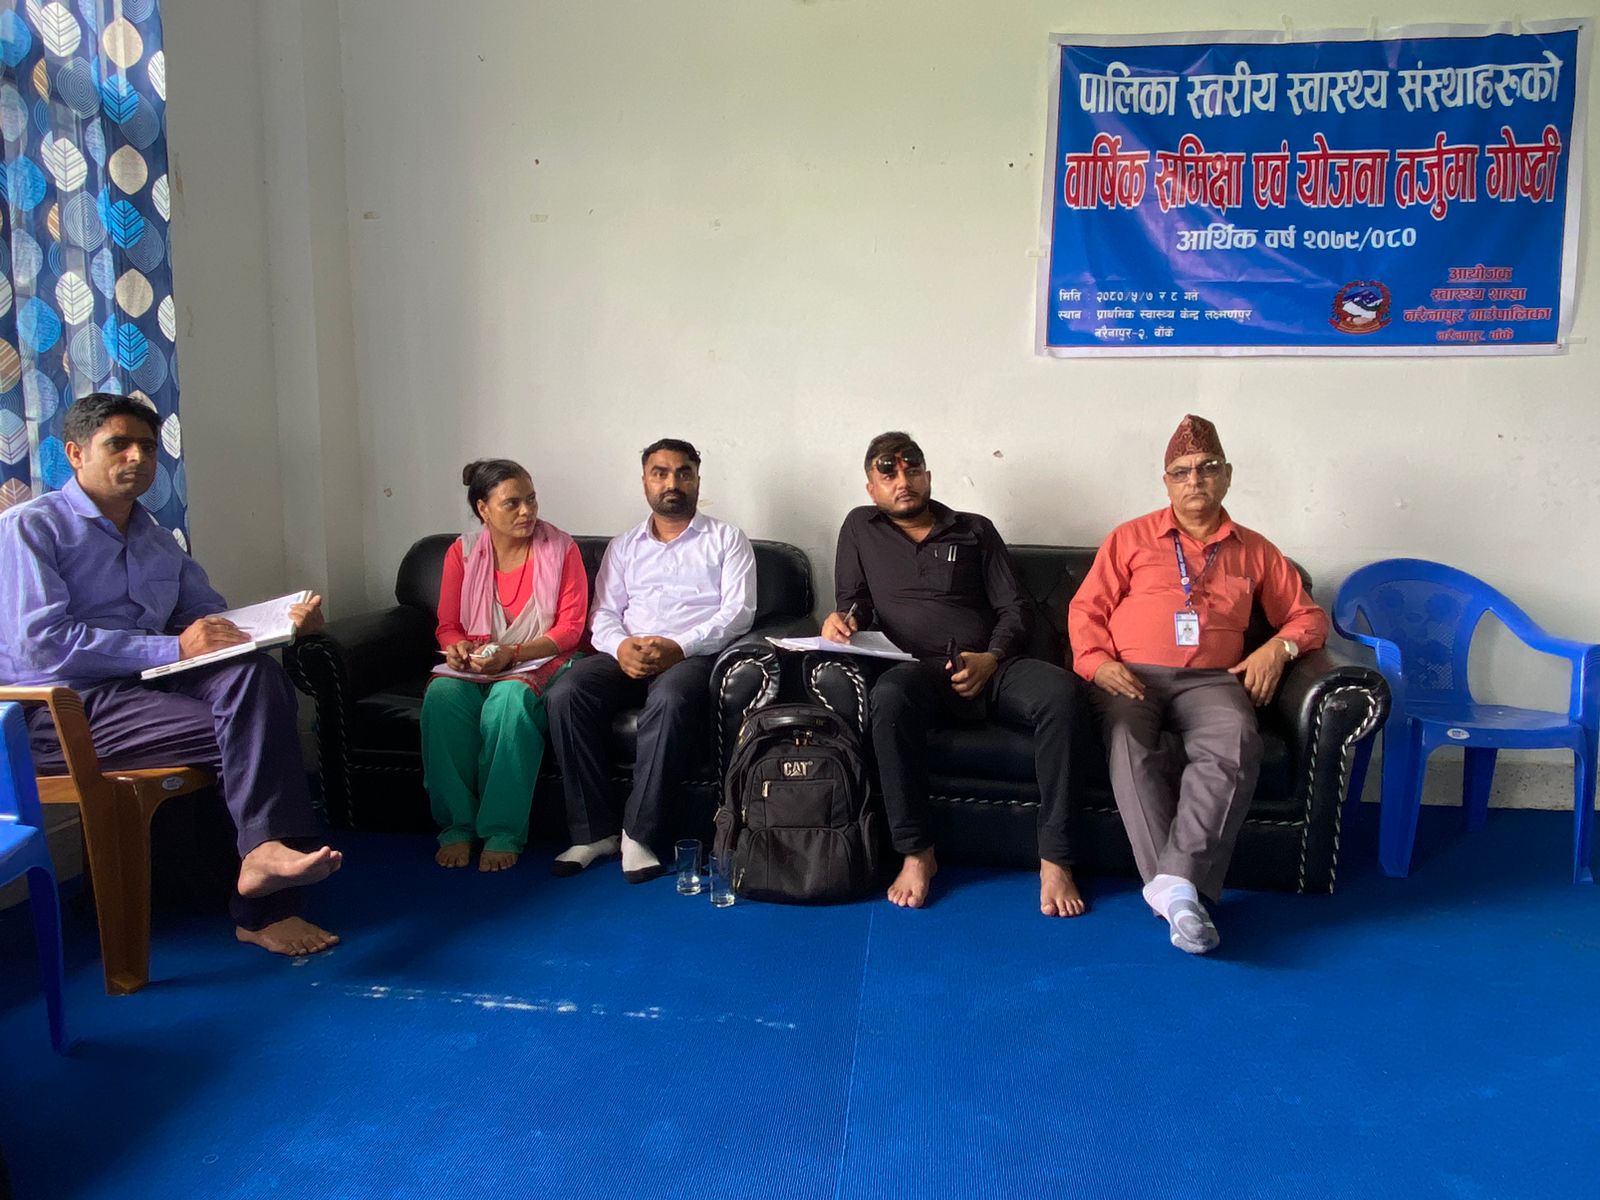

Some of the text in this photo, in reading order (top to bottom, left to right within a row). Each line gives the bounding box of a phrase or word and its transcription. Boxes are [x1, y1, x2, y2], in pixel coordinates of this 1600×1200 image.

[1080, 61, 1179, 116] पालिका
[1187, 61, 1278, 119] स्तरीय
[1287, 68, 1389, 117] स्वास्थ्य
[1064, 132, 1150, 210] वार्षिक
[1155, 133, 1246, 216] समिक्षा
[1252, 139, 1290, 210] एवं
[1296, 132, 1390, 209] योजना
[1395, 131, 1480, 221] तर्जुमा
[1176, 222, 1417, 252] आर्थिक वर्ष २०७९/०८०
[1448, 263, 1513, 281] आयोजक
[1488, 287, 1528, 301] शाखा
